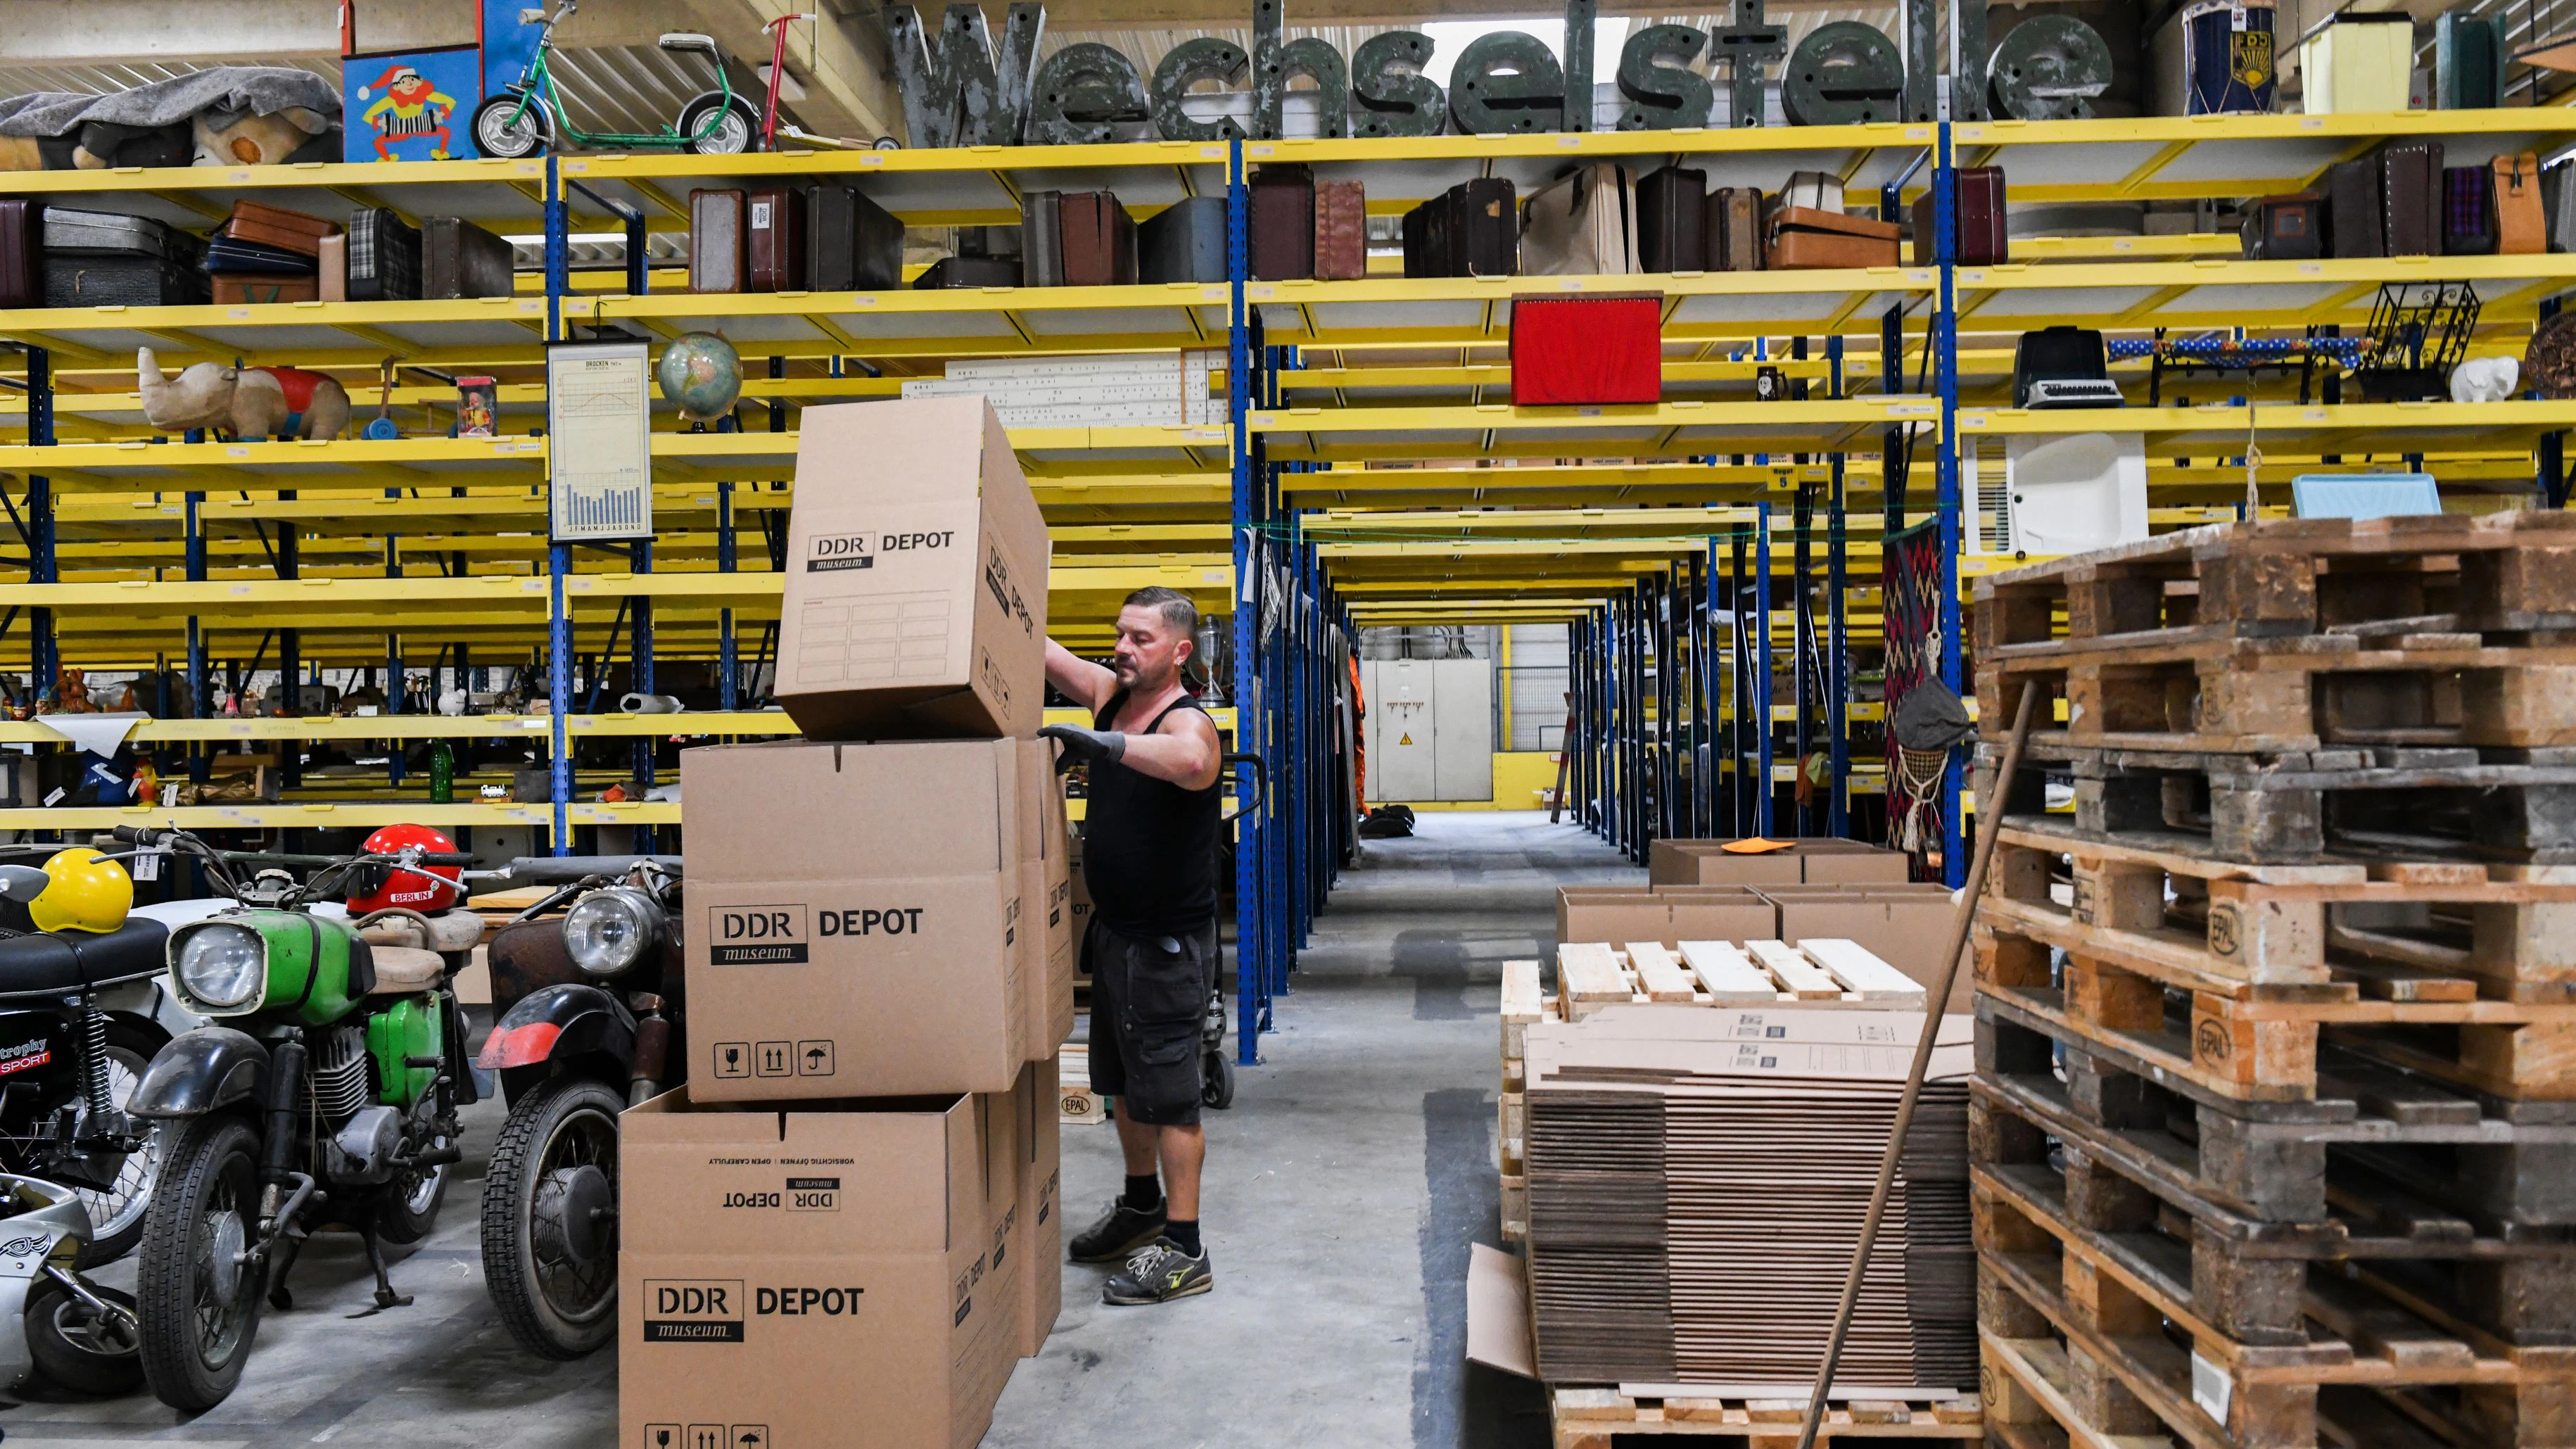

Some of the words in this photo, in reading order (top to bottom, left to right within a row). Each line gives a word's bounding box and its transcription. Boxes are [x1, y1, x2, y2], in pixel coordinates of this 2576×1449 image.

[883, 0, 2112, 148] Wechselstelle
[818, 538, 864, 555] DDR
[882, 531, 954, 551] DEPOT
[816, 558, 863, 569] museum
[991, 545, 1007, 592] DDR
[1012, 584, 1033, 639] DEPOT
[395, 892, 429, 902] BERLIN
[724, 913, 793, 938] DDR
[820, 909, 923, 936] DEPOT
[2213, 913, 2235, 947] EPAL
[723, 947, 796, 960] museum
[0, 1039, 47, 1059] trophy
[1, 1053, 48, 1073] SPORT
[1065, 1099, 1085, 1111] EPAL
[723, 1192, 780, 1208] DEPOT
[795, 1193, 832, 1207] DDR
[659, 1288, 728, 1314] DDR
[756, 1288, 864, 1315] DEPOT
[656, 1324, 732, 1337] museum
